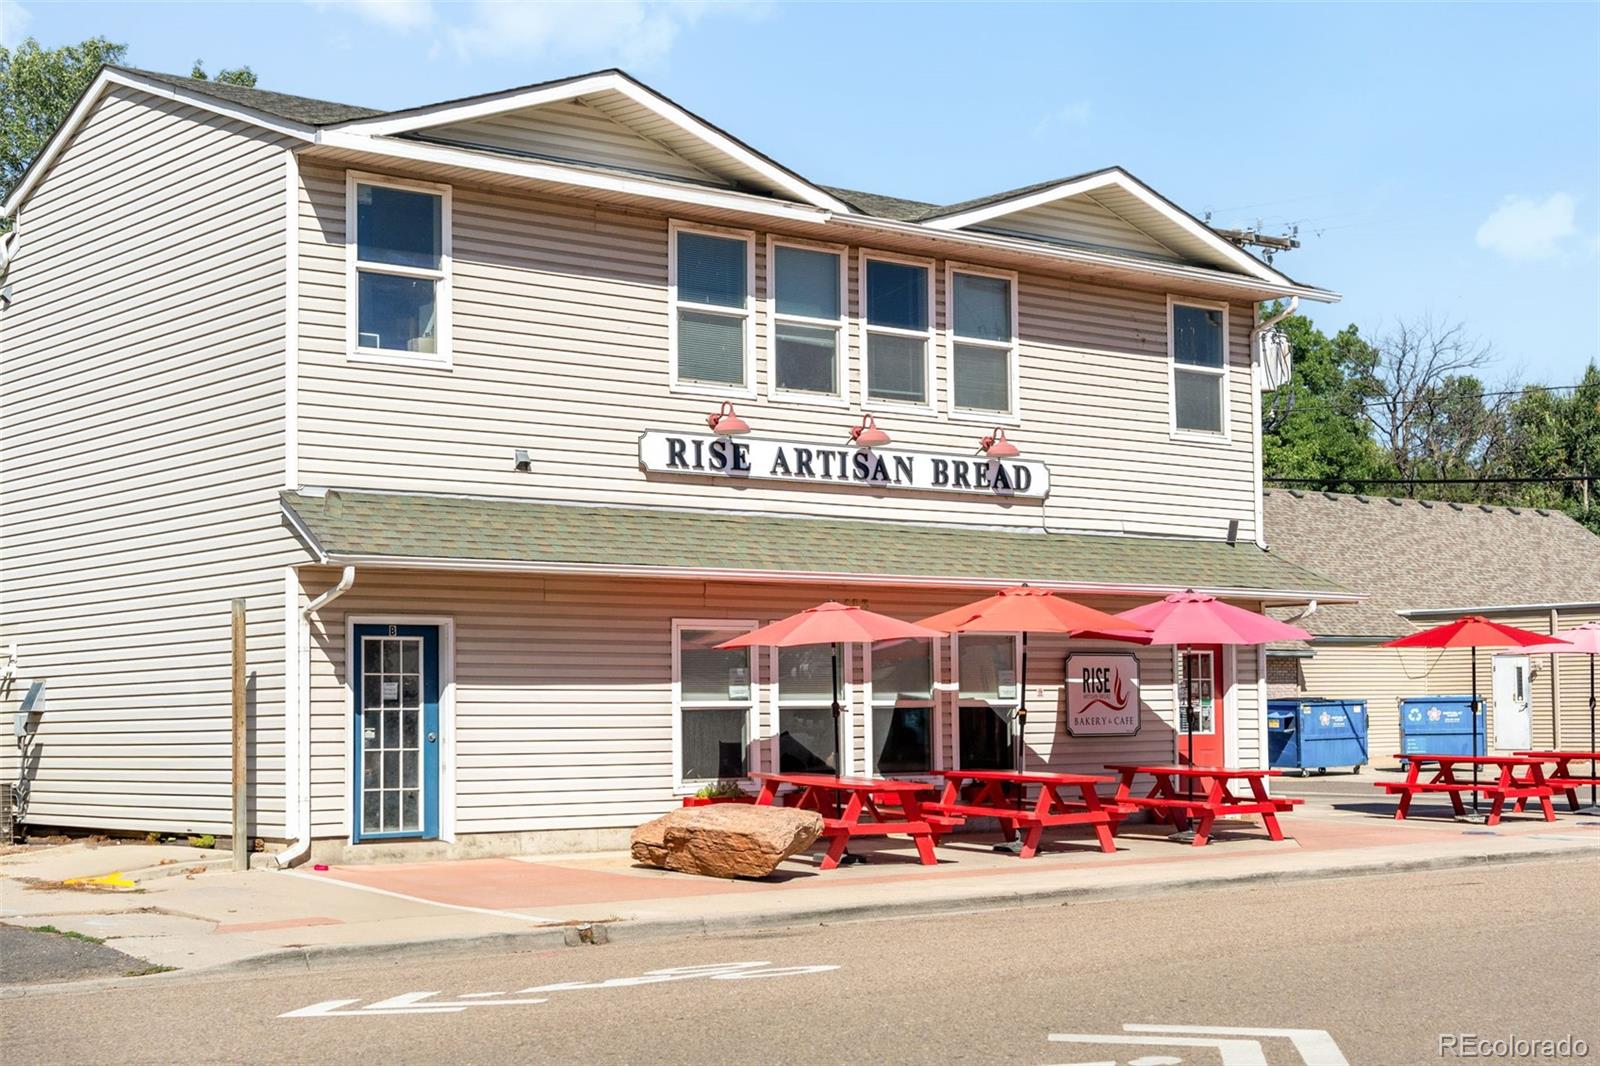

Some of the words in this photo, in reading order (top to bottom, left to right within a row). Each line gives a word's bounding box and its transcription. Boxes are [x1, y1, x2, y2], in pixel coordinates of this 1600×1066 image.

[665, 438, 751, 472] RISE
[770, 446, 914, 486] ARTISAN
[931, 458, 1032, 491] BREAD
[390, 625, 396, 636] B
[1083, 667, 1111, 694] RISE
[1074, 717, 1106, 726] BAKERY
